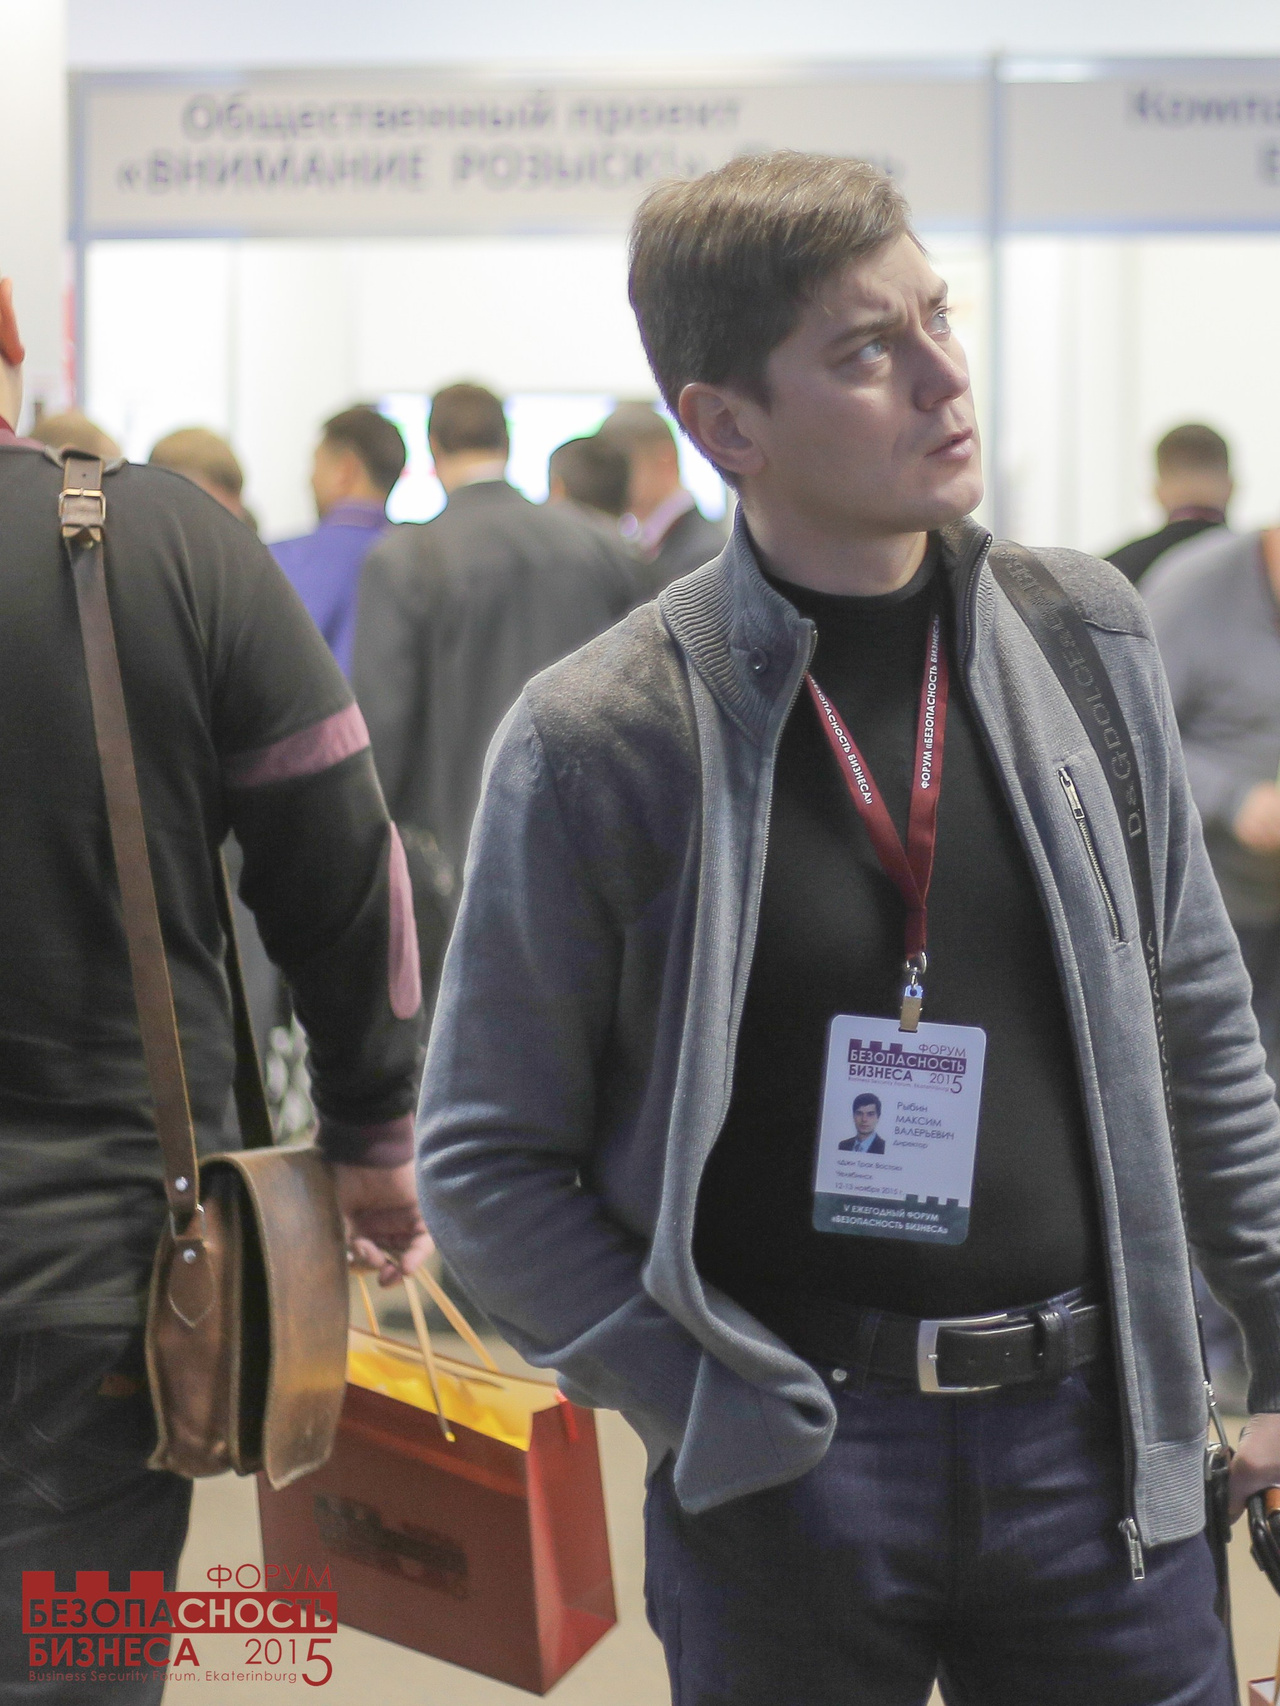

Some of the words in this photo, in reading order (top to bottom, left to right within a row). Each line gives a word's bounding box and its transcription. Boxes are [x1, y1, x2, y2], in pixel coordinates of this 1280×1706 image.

[924, 665, 938, 749] «БЕЗОПАСНОСТЬ
[847, 753, 873, 805] БИЗНЕСА»
[920, 750, 933, 790] ФОРУМ
[918, 1043, 966, 1058] ФОРУМ
[850, 1049, 965, 1073] БЕЗОПАСНОСТЬ
[849, 1064, 913, 1081] БИЗНЕСА
[929, 1072, 963, 1094] 2015
[896, 1101, 928, 1112] Рыбин
[895, 1115, 942, 1127] МАКСИМ
[894, 1125, 955, 1140] ВАЛЕРЬЕВИЧ
[831, 1215, 904, 1229] «БЕЗОПАСНОСТЬ
[843, 1204, 850, 1212] V
[851, 1205, 906, 1218] ЕЖЕГОДНЫЙ
[906, 1211, 940, 1222] ФОРУМ
